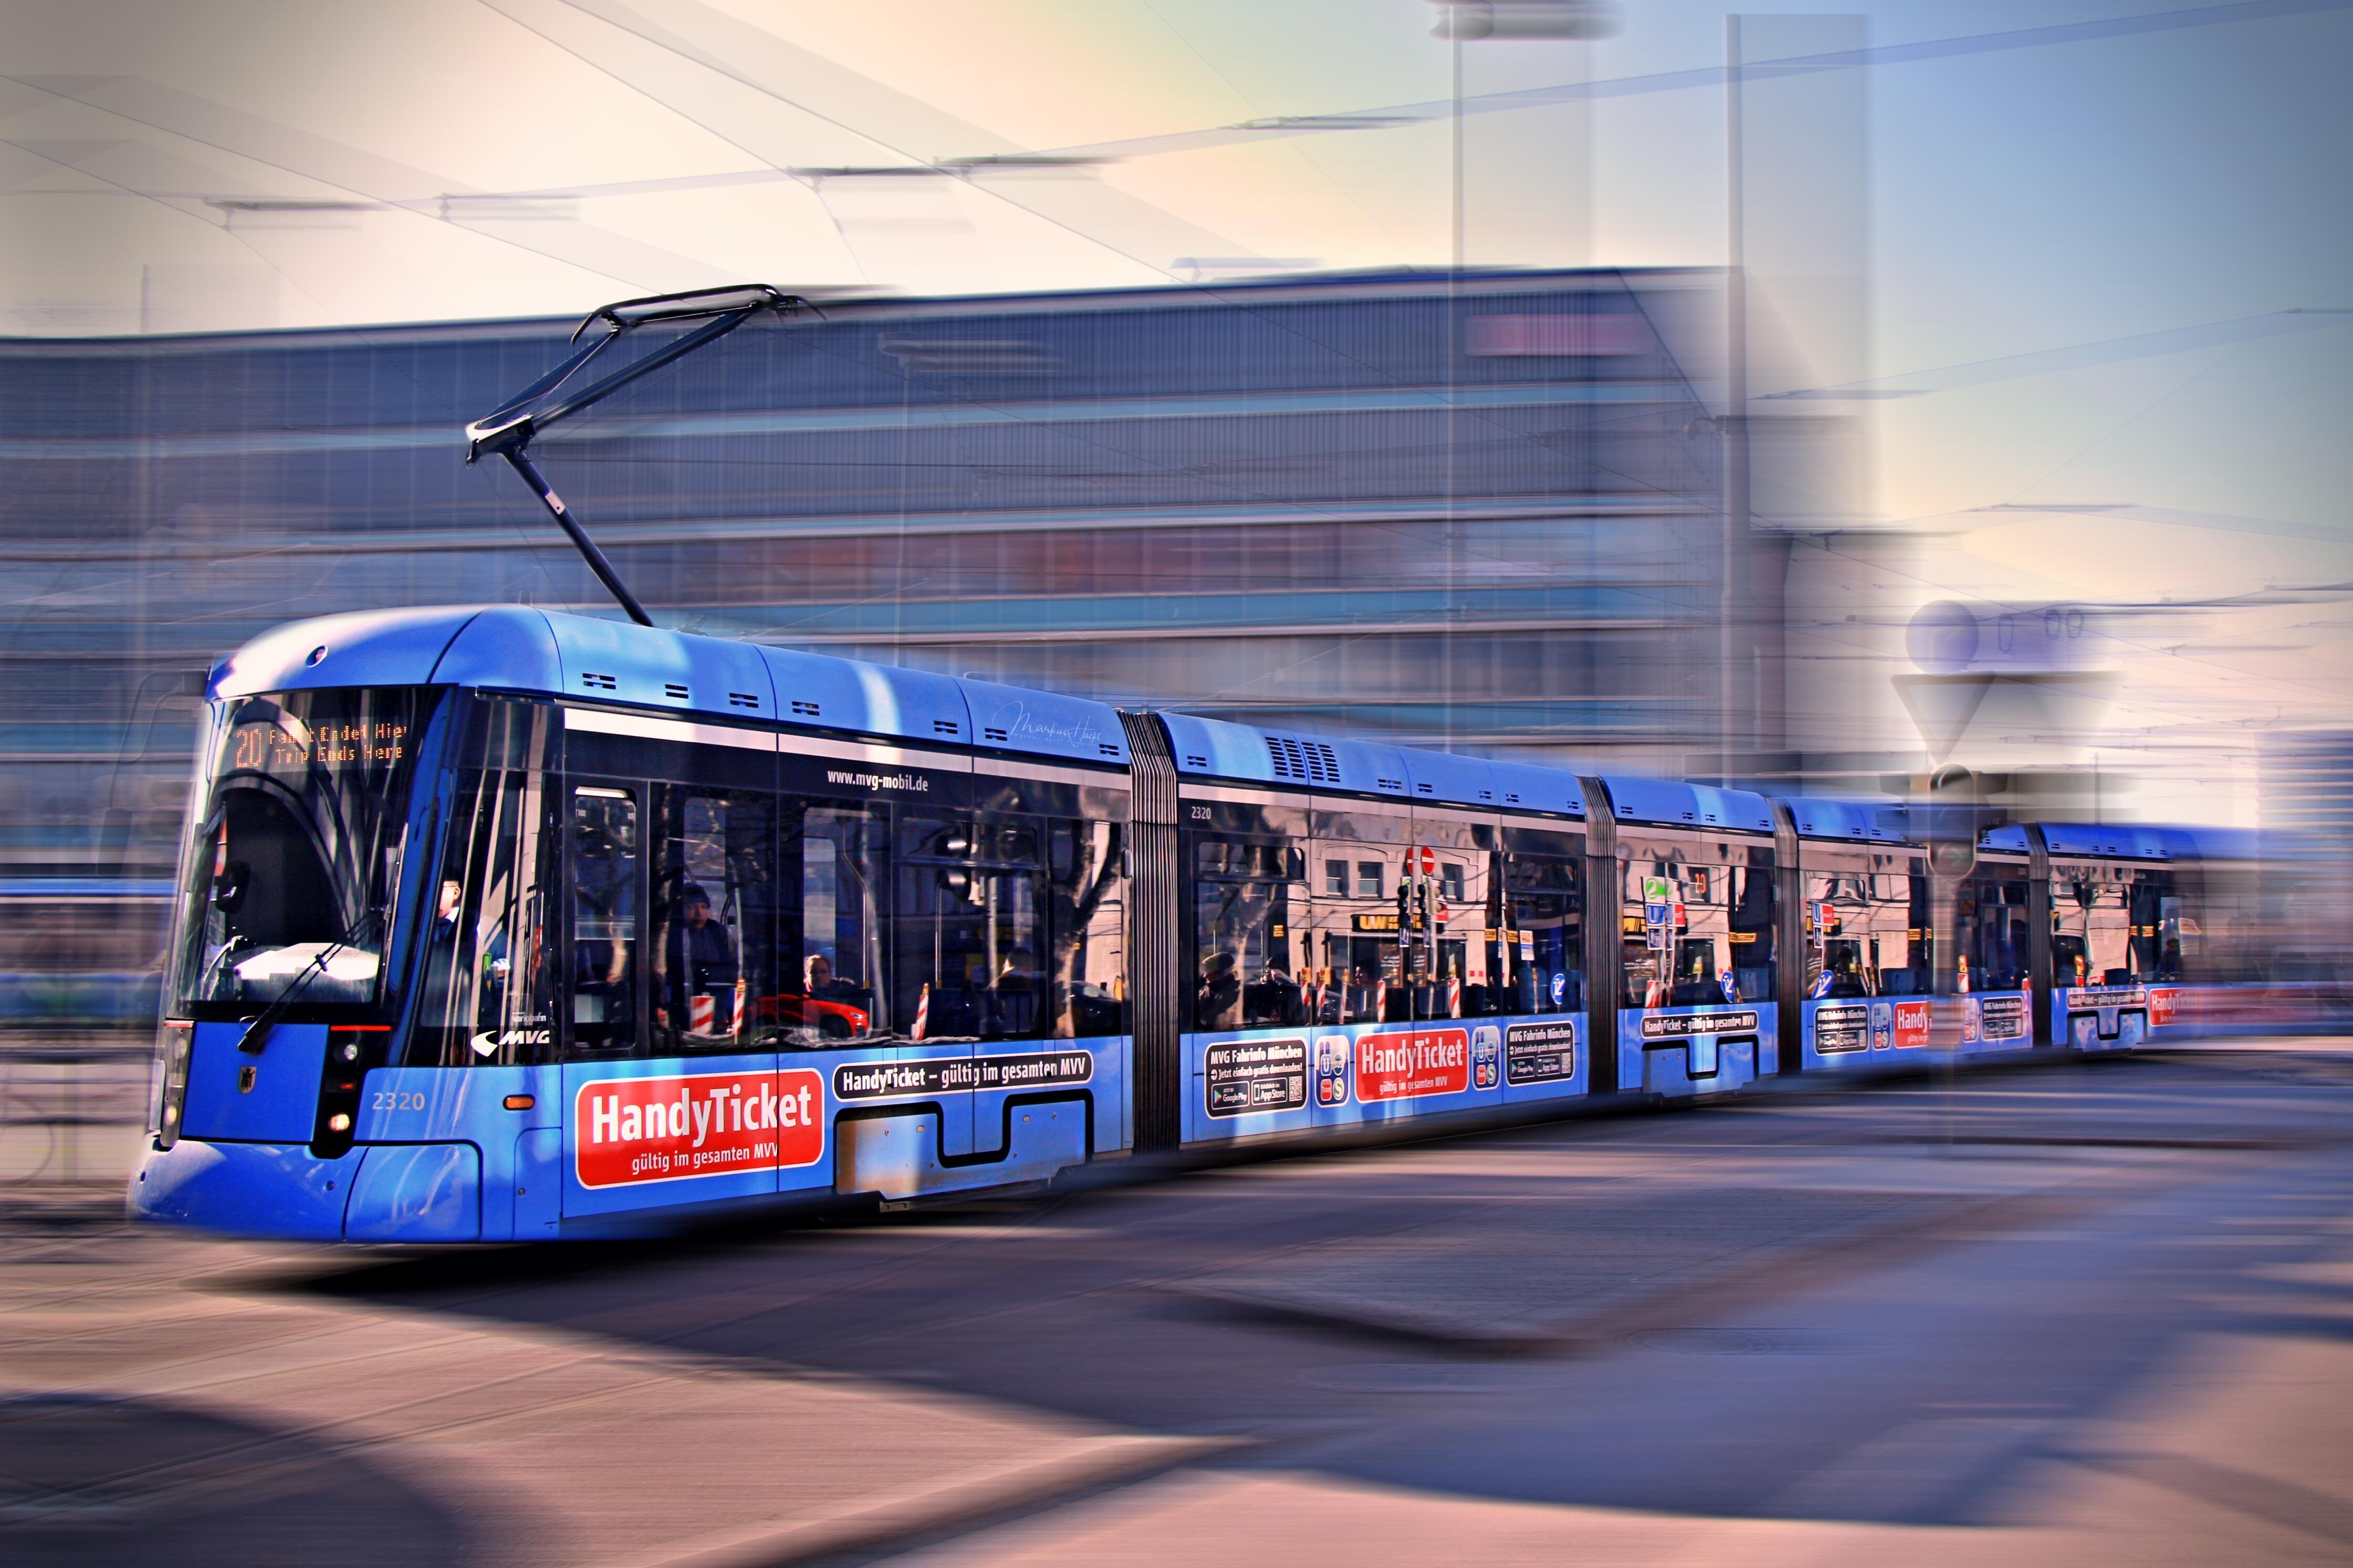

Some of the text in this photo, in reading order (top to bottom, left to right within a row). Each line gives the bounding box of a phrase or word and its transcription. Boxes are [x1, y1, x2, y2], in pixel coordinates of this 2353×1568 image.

[237, 729, 262, 767] 20
[275, 744, 403, 764] Trip Ends Here
[828, 771, 928, 792] www.mvg-mobil.de
[1191, 806, 1211, 819] 2320
[513, 1012, 546, 1023] variobahn
[1645, 1018, 1681, 1034] HandyTicket
[1688, 1017, 1706, 1033] gültig
[1706, 1017, 1714, 1028] im
[1742, 1015, 1755, 1026] MVV
[1897, 1006, 1932, 1033] Handy
[498, 1030, 550, 1045] MVG
[1509, 1027, 1571, 1042] MVG Fahrinfo München
[1211, 1045, 1302, 1065] MVG Fahrinfo München
[1362, 1037, 1463, 1078] HandyTicket
[843, 1067, 926, 1093] HandyTicket
[942, 1064, 980, 1088] gültig
[983, 1062, 998, 1080] im
[1001, 1061, 1058, 1084] gesamten
[1061, 1057, 1086, 1076] MVV
[1218, 1062, 1303, 1080] Jetzt einfach gratis downloaden!
[1260, 1089, 1285, 1101] App Store
[1379, 1076, 1448, 1095] gültig im gesamten MVV
[372, 1092, 425, 1110] 2320
[1223, 1092, 1248, 1103] Google Play
[592, 1083, 812, 1148] HandyTicket
[632, 1142, 778, 1175] gültig im gesamten MVV
